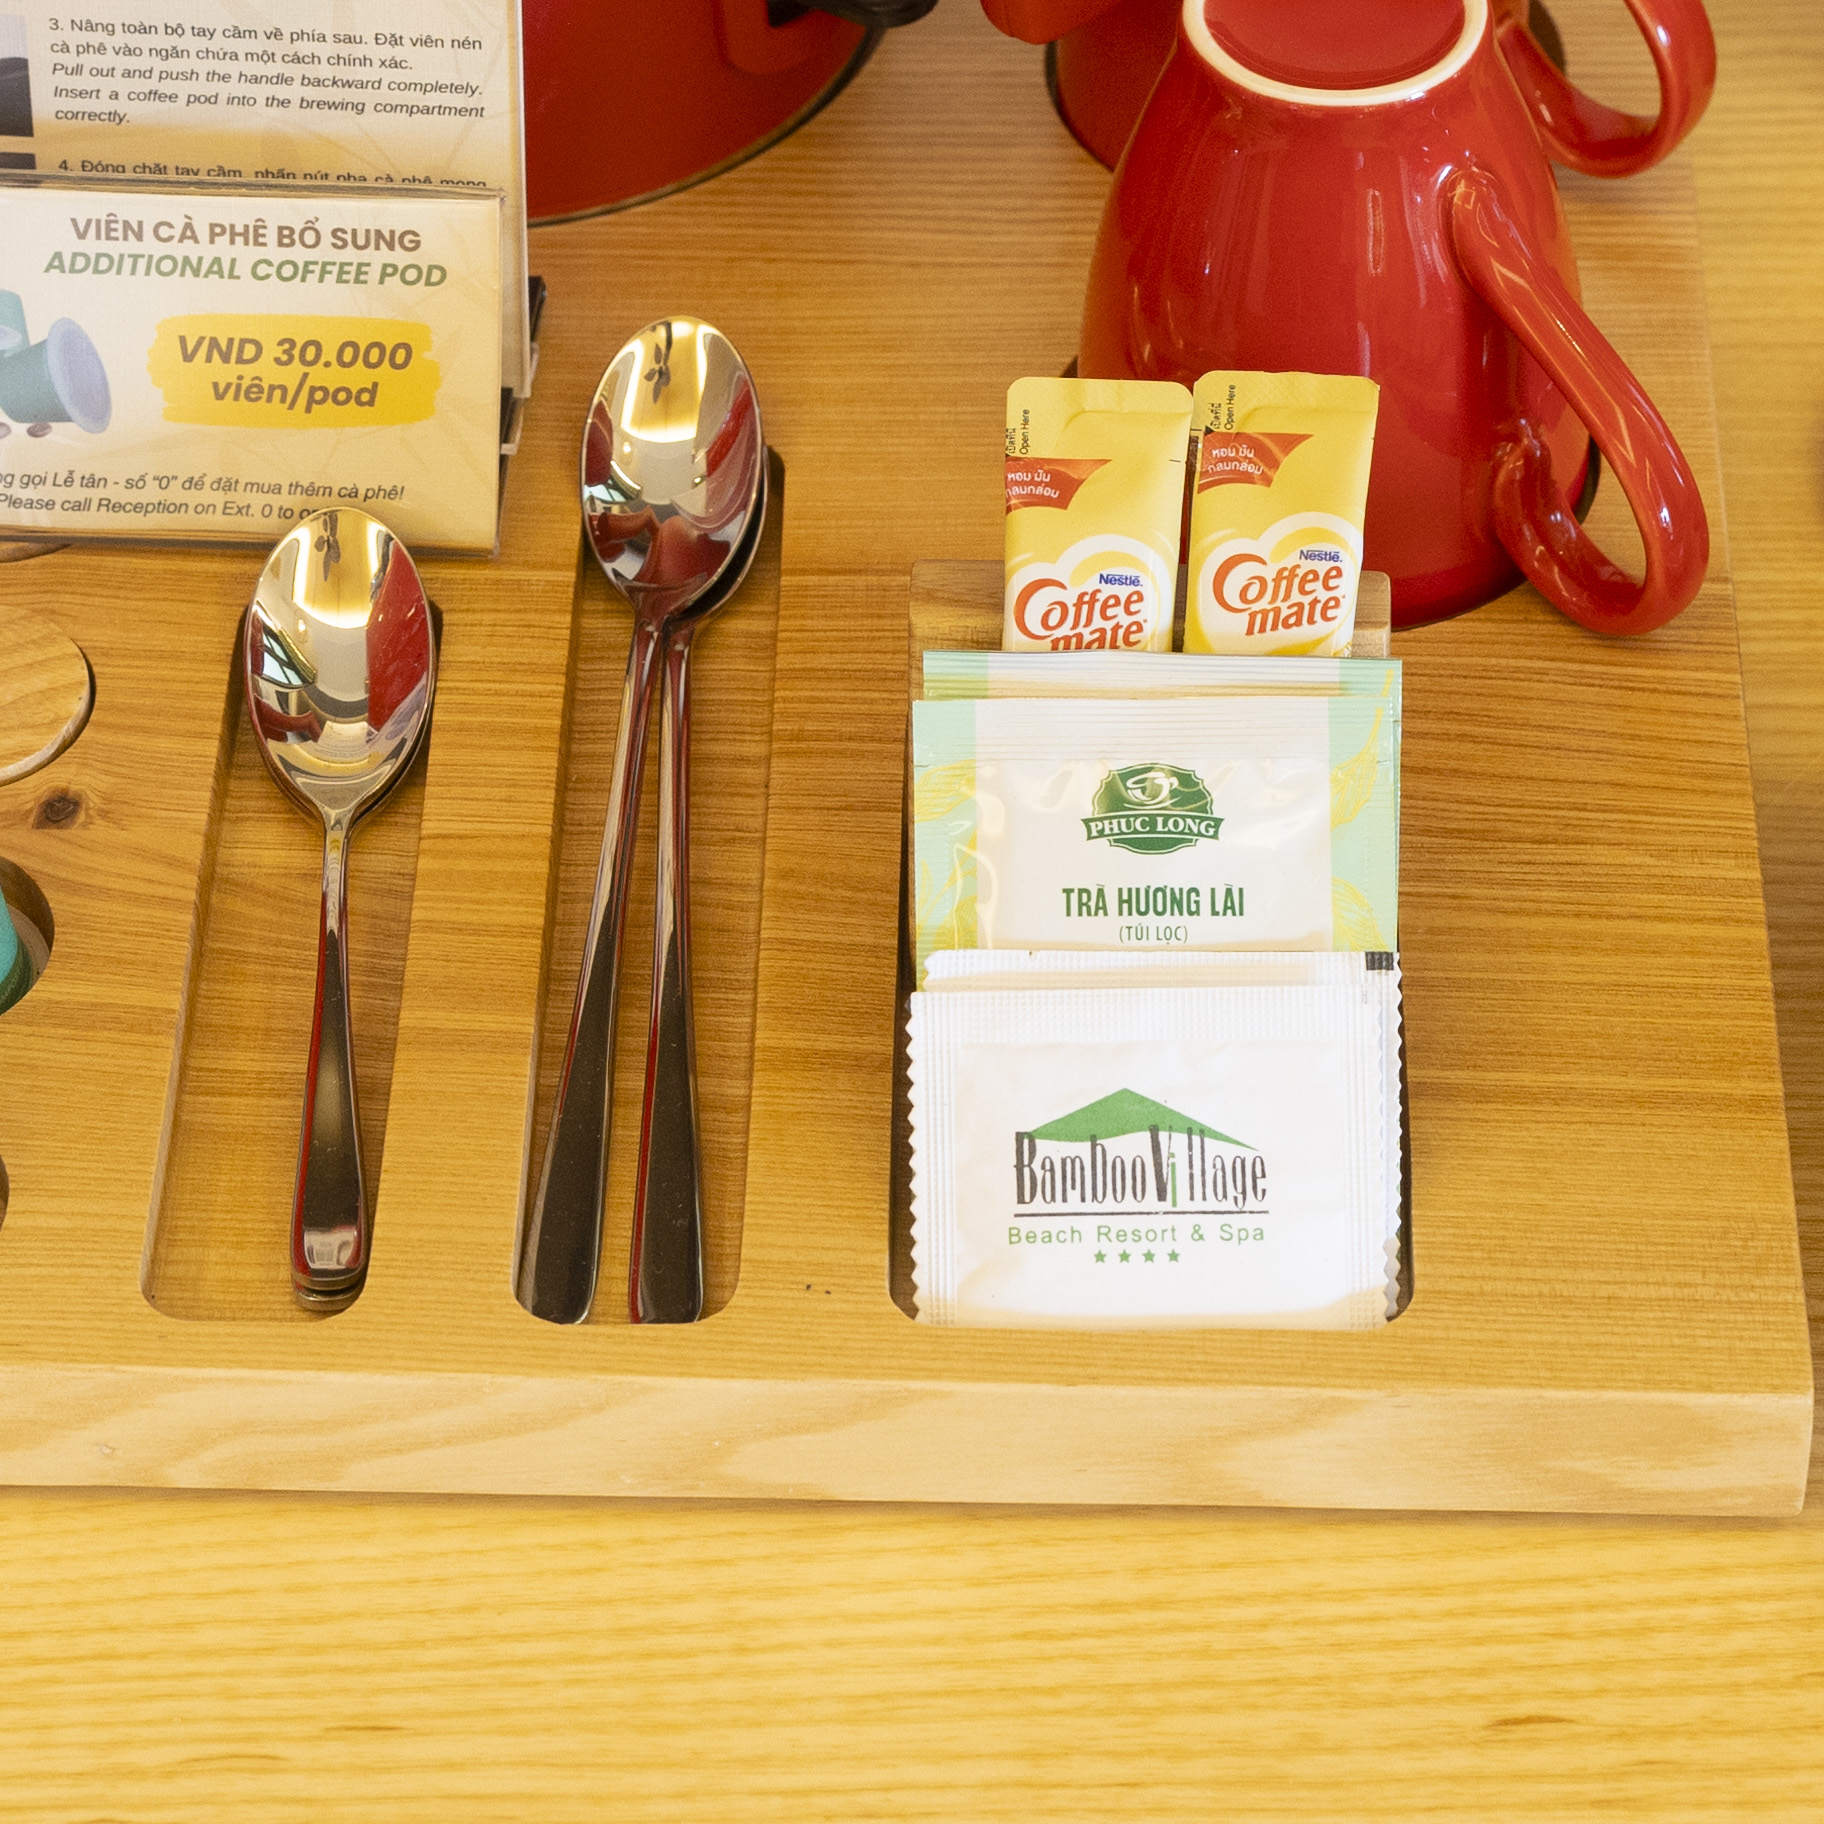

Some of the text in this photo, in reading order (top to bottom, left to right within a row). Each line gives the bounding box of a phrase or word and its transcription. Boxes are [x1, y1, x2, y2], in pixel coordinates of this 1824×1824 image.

[49, 18, 481, 50] 3. Nâng toàn tay phía sau. viên nén
[51, 41, 412, 70] cà phê vào ngăn chứa một cách chính xác.
[52, 63, 483, 97] Pull out and push the handle backward completely.
[54, 86, 484, 117] Insert a coffee pod into the brewing compartment
[55, 109, 129, 125] correctly.
[70, 213, 421, 252] VIÊN CÀ PHÊ BỔ SUNG
[44, 251, 446, 287] ADDITIONAL COFFEE POD
[178, 335, 413, 370] VND 30.000
[212, 373, 379, 414] viên/pod
[1224, 385, 1236, 430] Open Here
[1019, 430, 1029, 454] Open
[20, 472, 47, 490] gọi
[80, 474, 107, 488] tân
[210, 476, 239, 495] đặt
[244, 480, 282, 495] mua
[288, 482, 332, 497] thêm
[338, 484, 358, 499] cà
[364, 485, 404, 502] phê!
[61, 497, 92, 511] call
[96, 497, 188, 517] Reception
[194, 503, 215, 516] on
[223, 501, 254, 517] Ext.
[262, 504, 272, 518] 0
[278, 506, 293, 519] to
[1213, 553, 1343, 613] Coffee
[1014, 578, 1144, 640] Coffee
[1245, 596, 1341, 636] mate
[1051, 621, 1143, 650] mate
[1089, 816, 1216, 836] PHUC LONG
[1062, 884, 1244, 917] TRÀ HƯƠNG LÀI
[1119, 923, 1150, 943] (TÚI
[1008, 1224, 1264, 1245] Beach Resort & Spa
